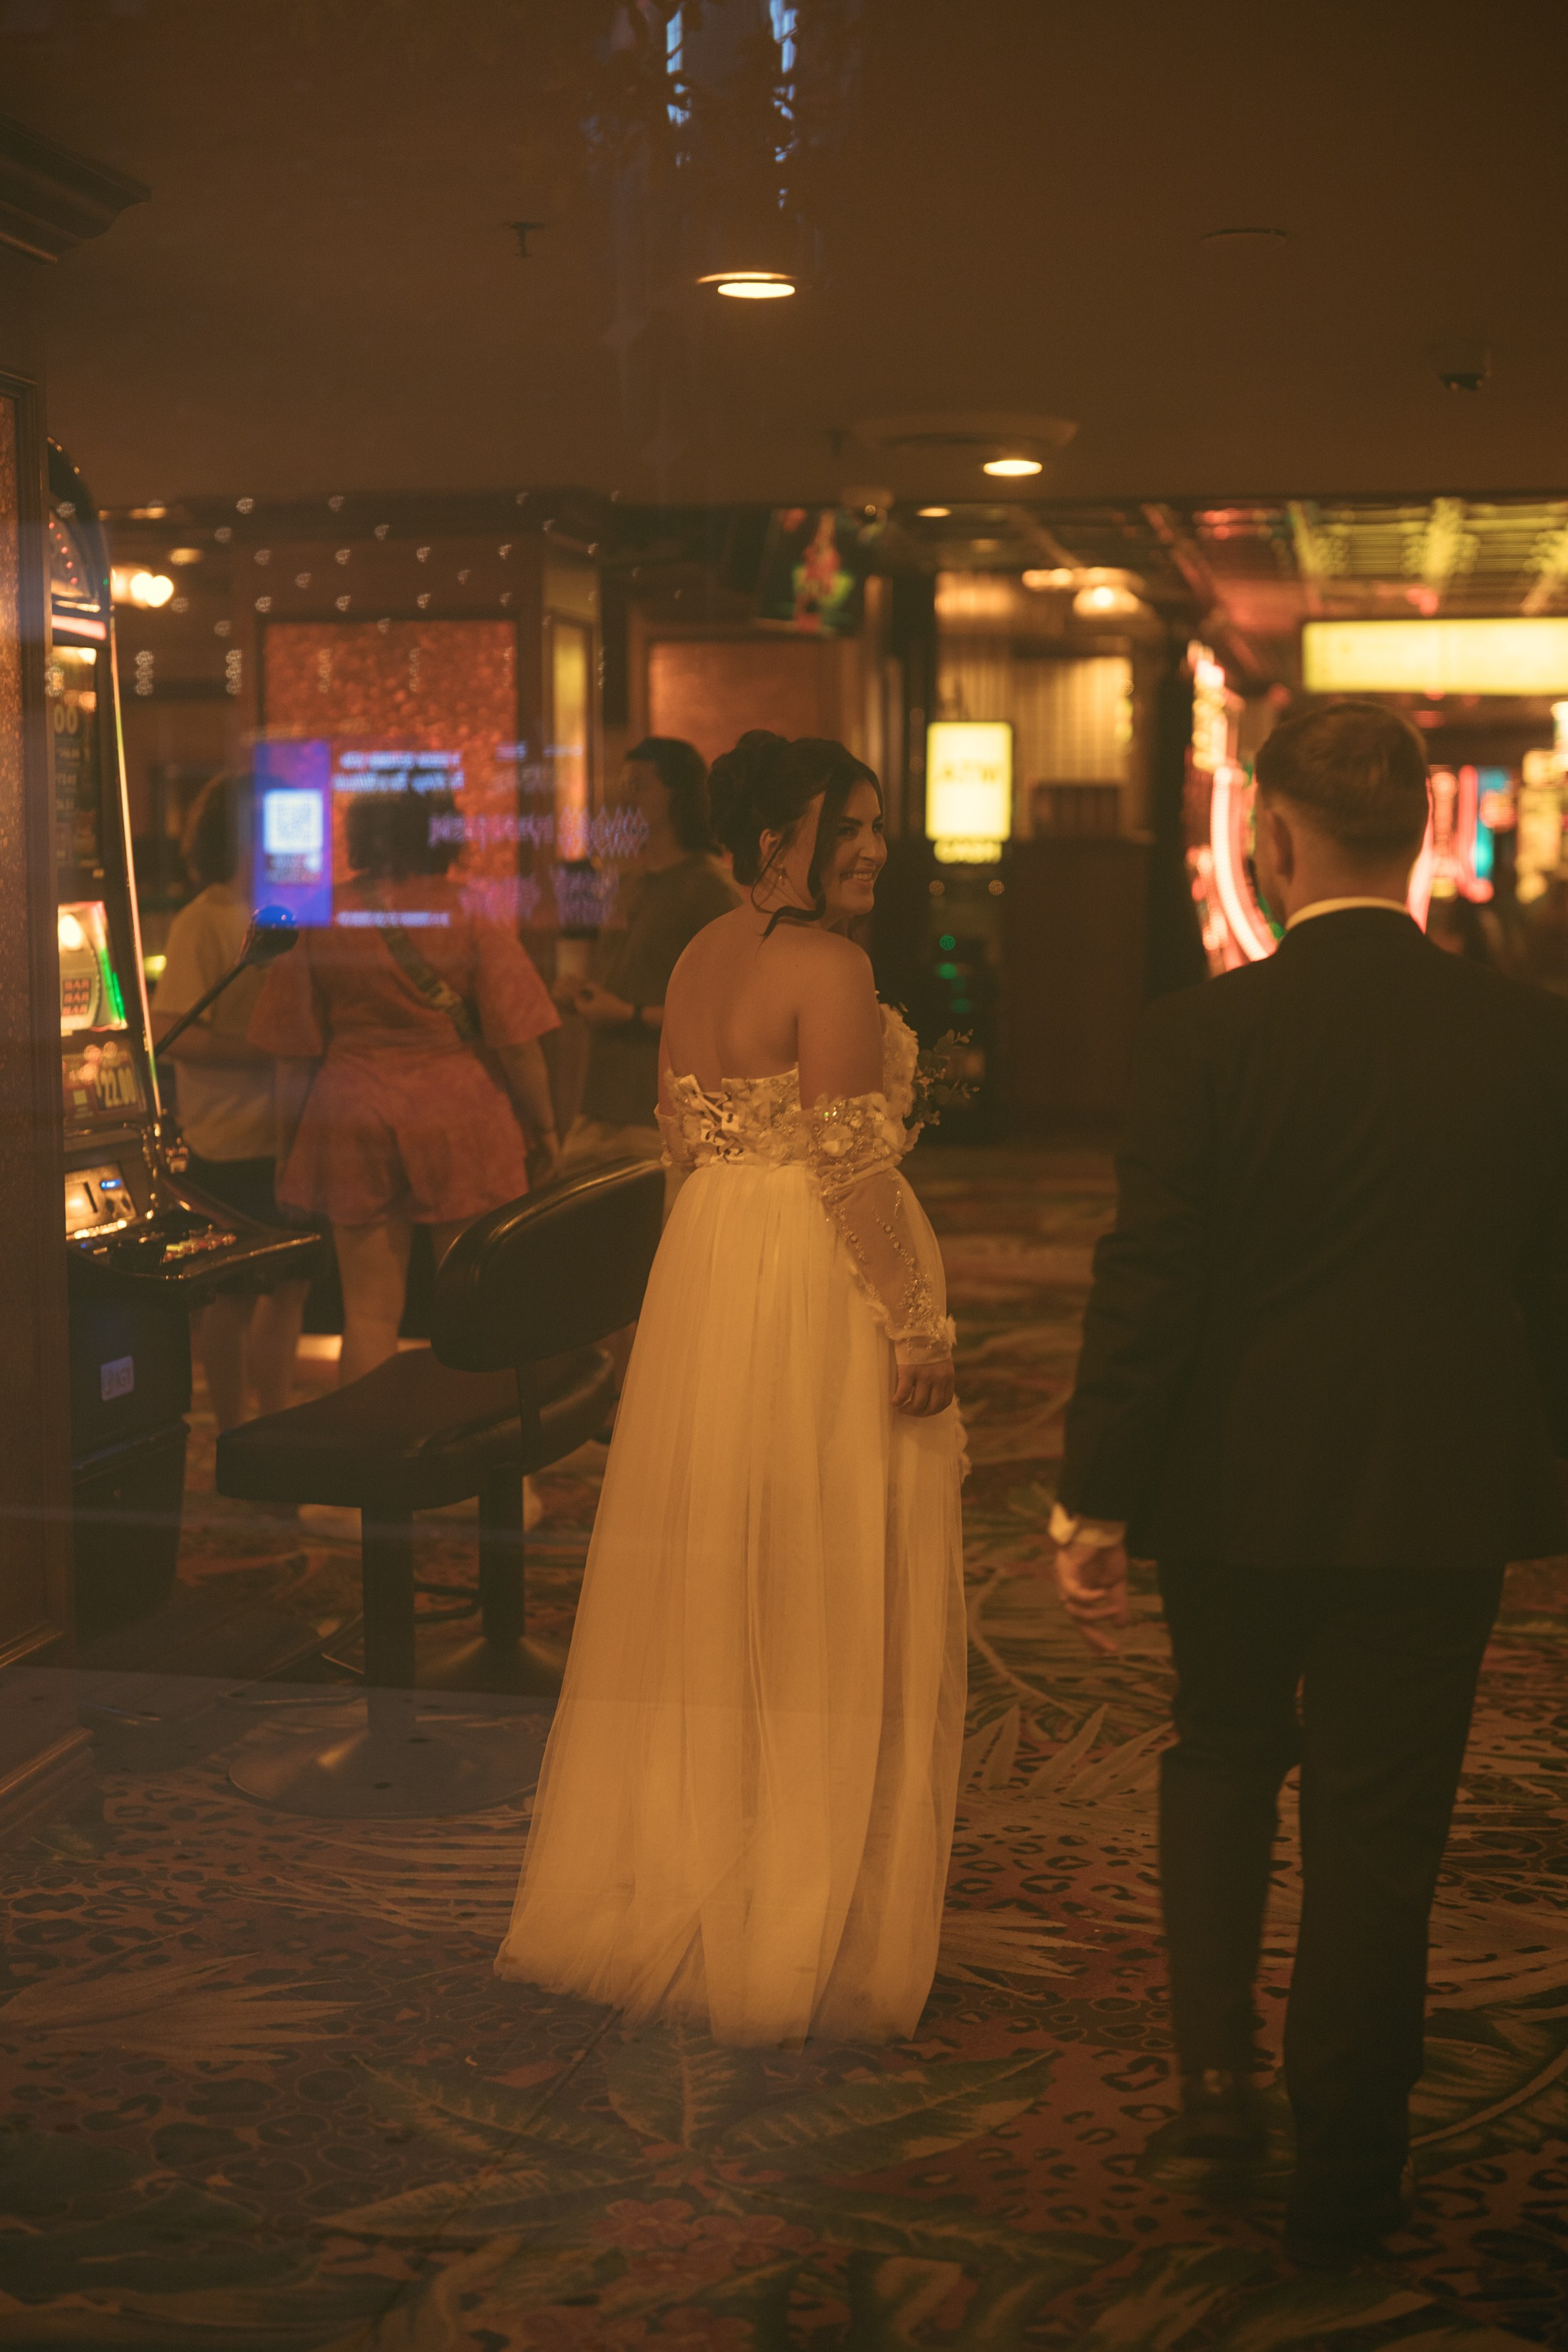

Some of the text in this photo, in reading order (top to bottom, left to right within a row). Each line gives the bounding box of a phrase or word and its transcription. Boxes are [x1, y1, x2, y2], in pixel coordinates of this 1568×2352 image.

[63, 979, 90, 990] BAR
[63, 991, 89, 1003] BAR
[61, 1004, 88, 1016] BAR
